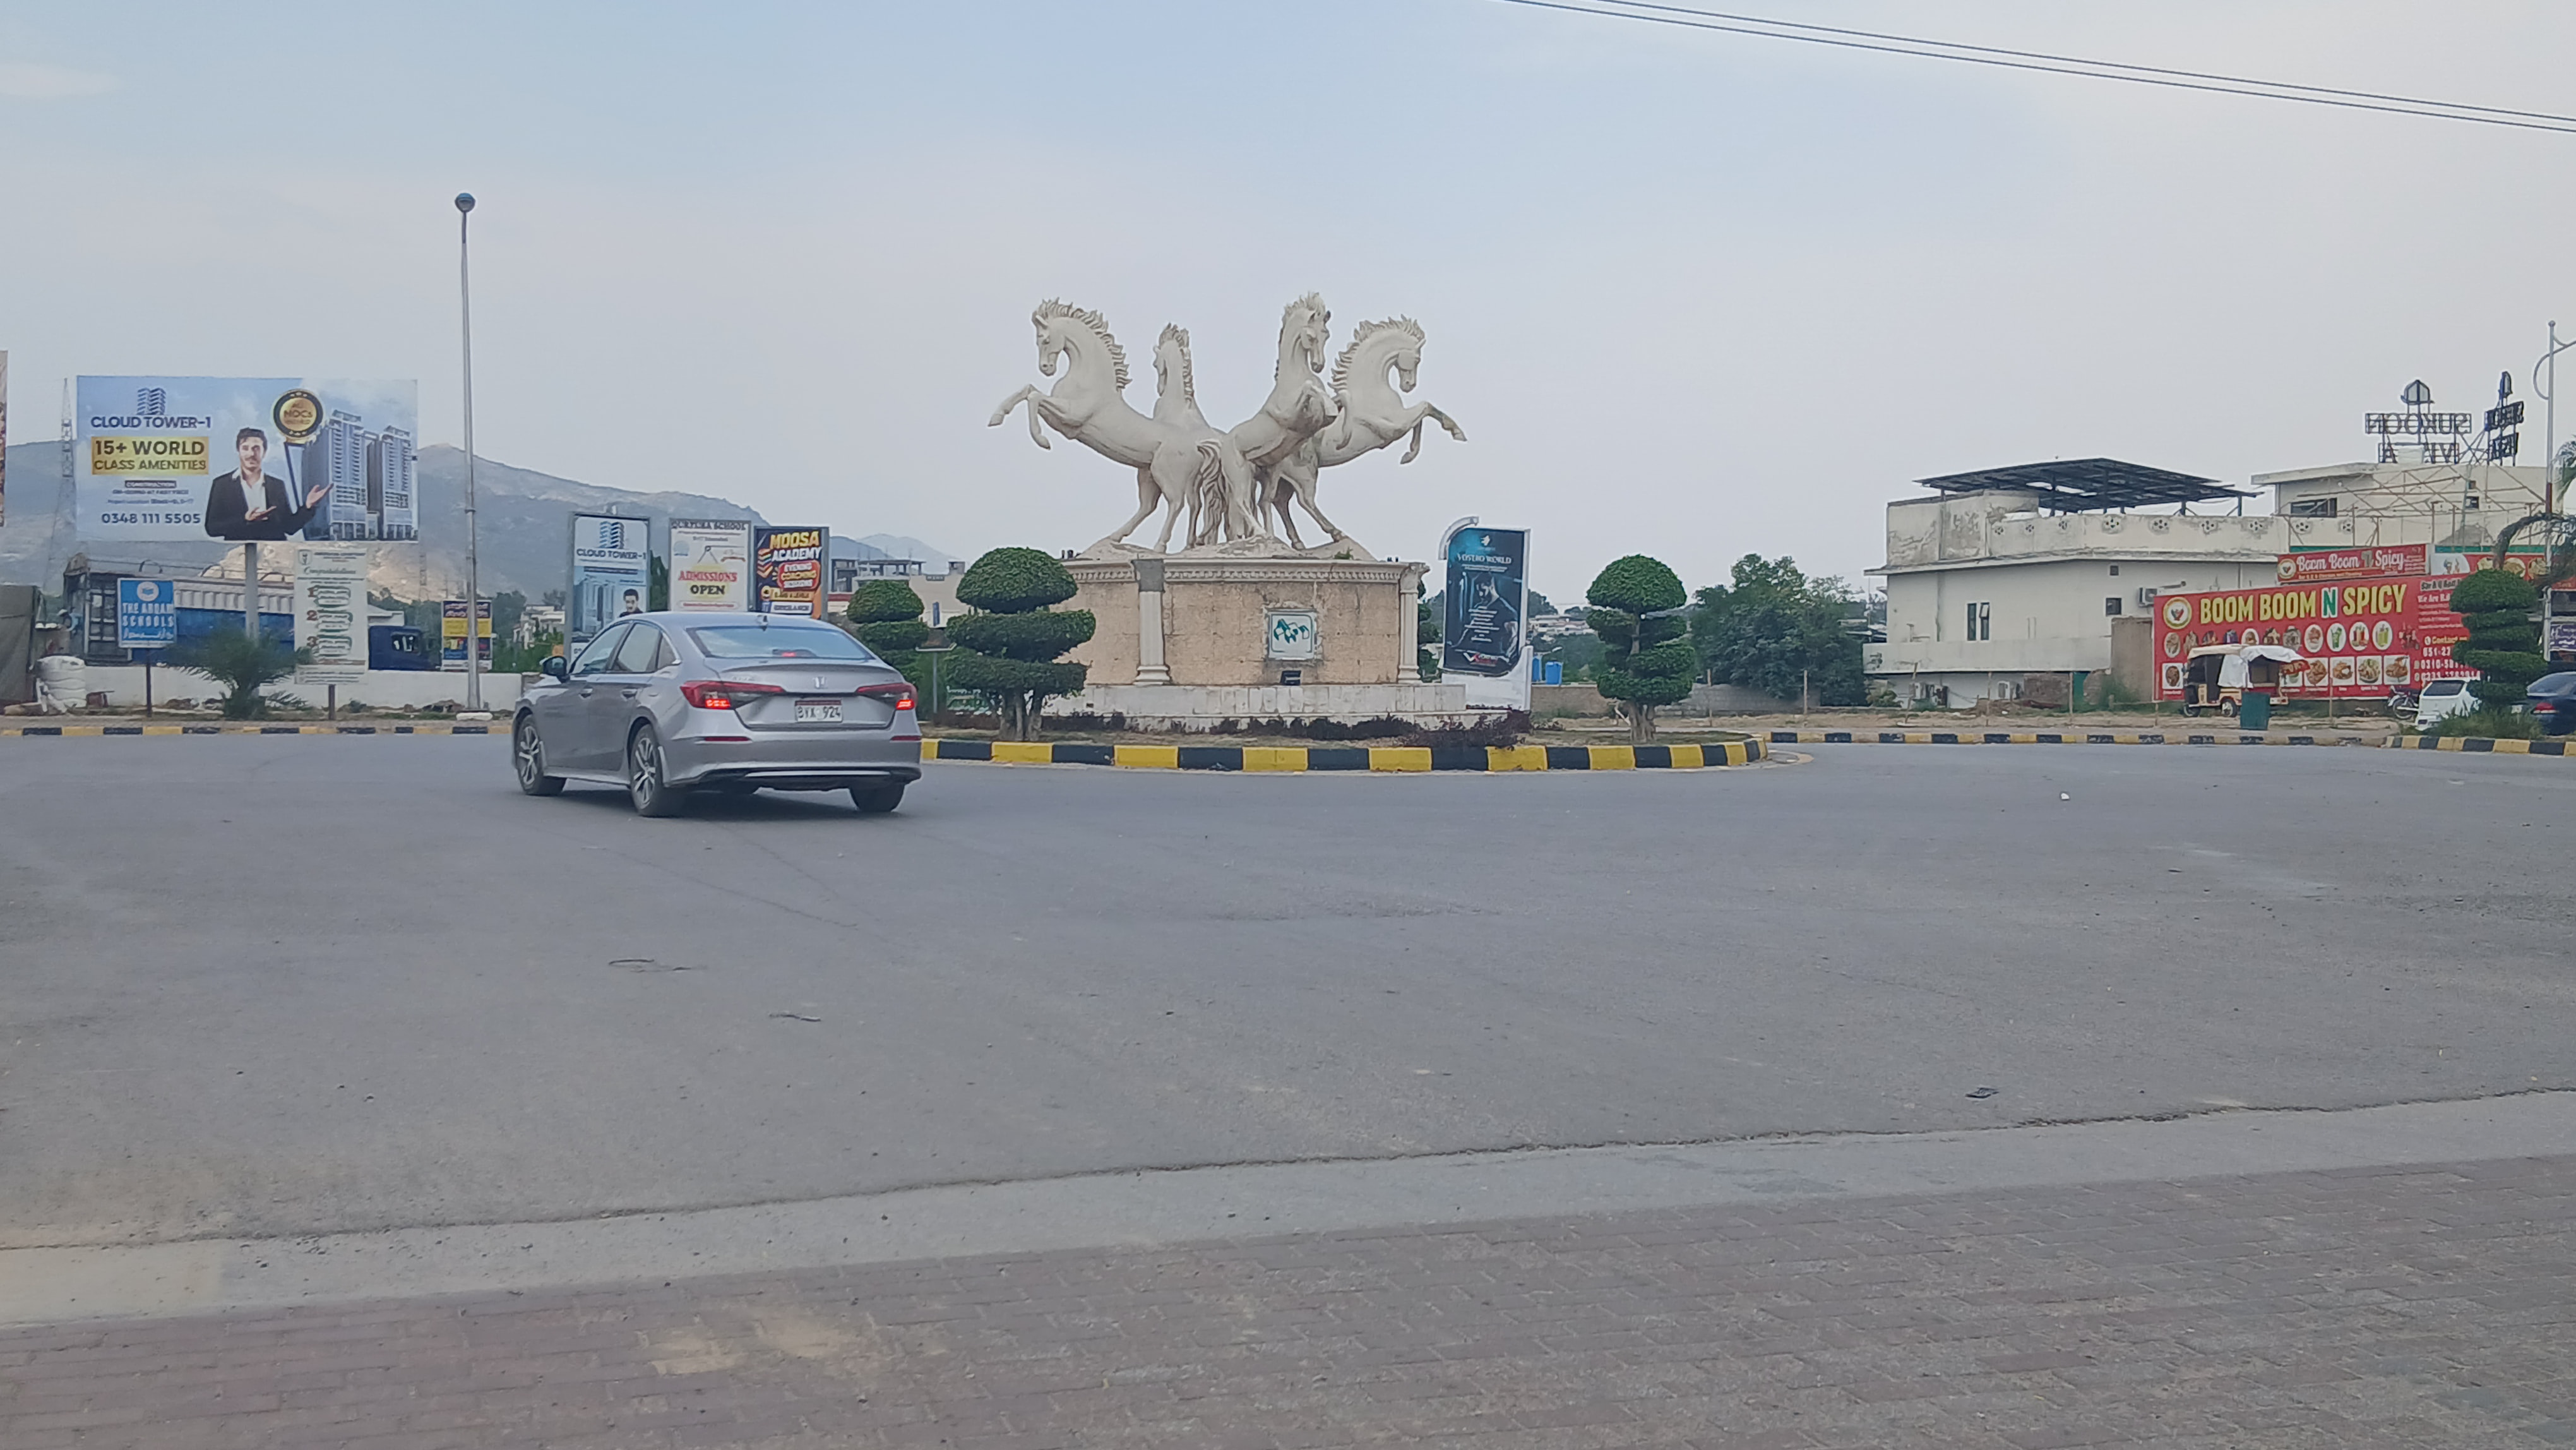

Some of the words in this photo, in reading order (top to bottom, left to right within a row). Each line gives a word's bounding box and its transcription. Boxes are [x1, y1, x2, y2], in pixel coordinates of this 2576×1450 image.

[90, 416, 142, 428] CLOUD
[143, 416, 212, 429] TOWER-1
[95, 440, 128, 455] 15+
[132, 440, 205, 455] WORLD
[94, 460, 135, 470] CLASS
[138, 460, 206, 470] AMENITIES
[101, 513, 138, 524] 0348
[141, 513, 160, 524] 111
[164, 513, 201, 524] 5505
[770, 531, 820, 549] MOOSA
[576, 548, 606, 558] CLOUD
[607, 550, 647, 560] TOWER-1
[771, 546, 823, 562] ACADEMY
[1486, 556, 1512, 564] WORLD
[2375, 549, 2404, 571] Spicy
[677, 570, 738, 582] ADMISSIONS
[690, 584, 726, 595] OPEN
[122, 602, 139, 614] THE
[2200, 594, 2254, 624] BOOM
[2259, 590, 2317, 621] BOOM
[2321, 587, 2338, 618] N
[2342, 584, 2407, 616] SPICY
[122, 615, 174, 627] SCHOOLS
